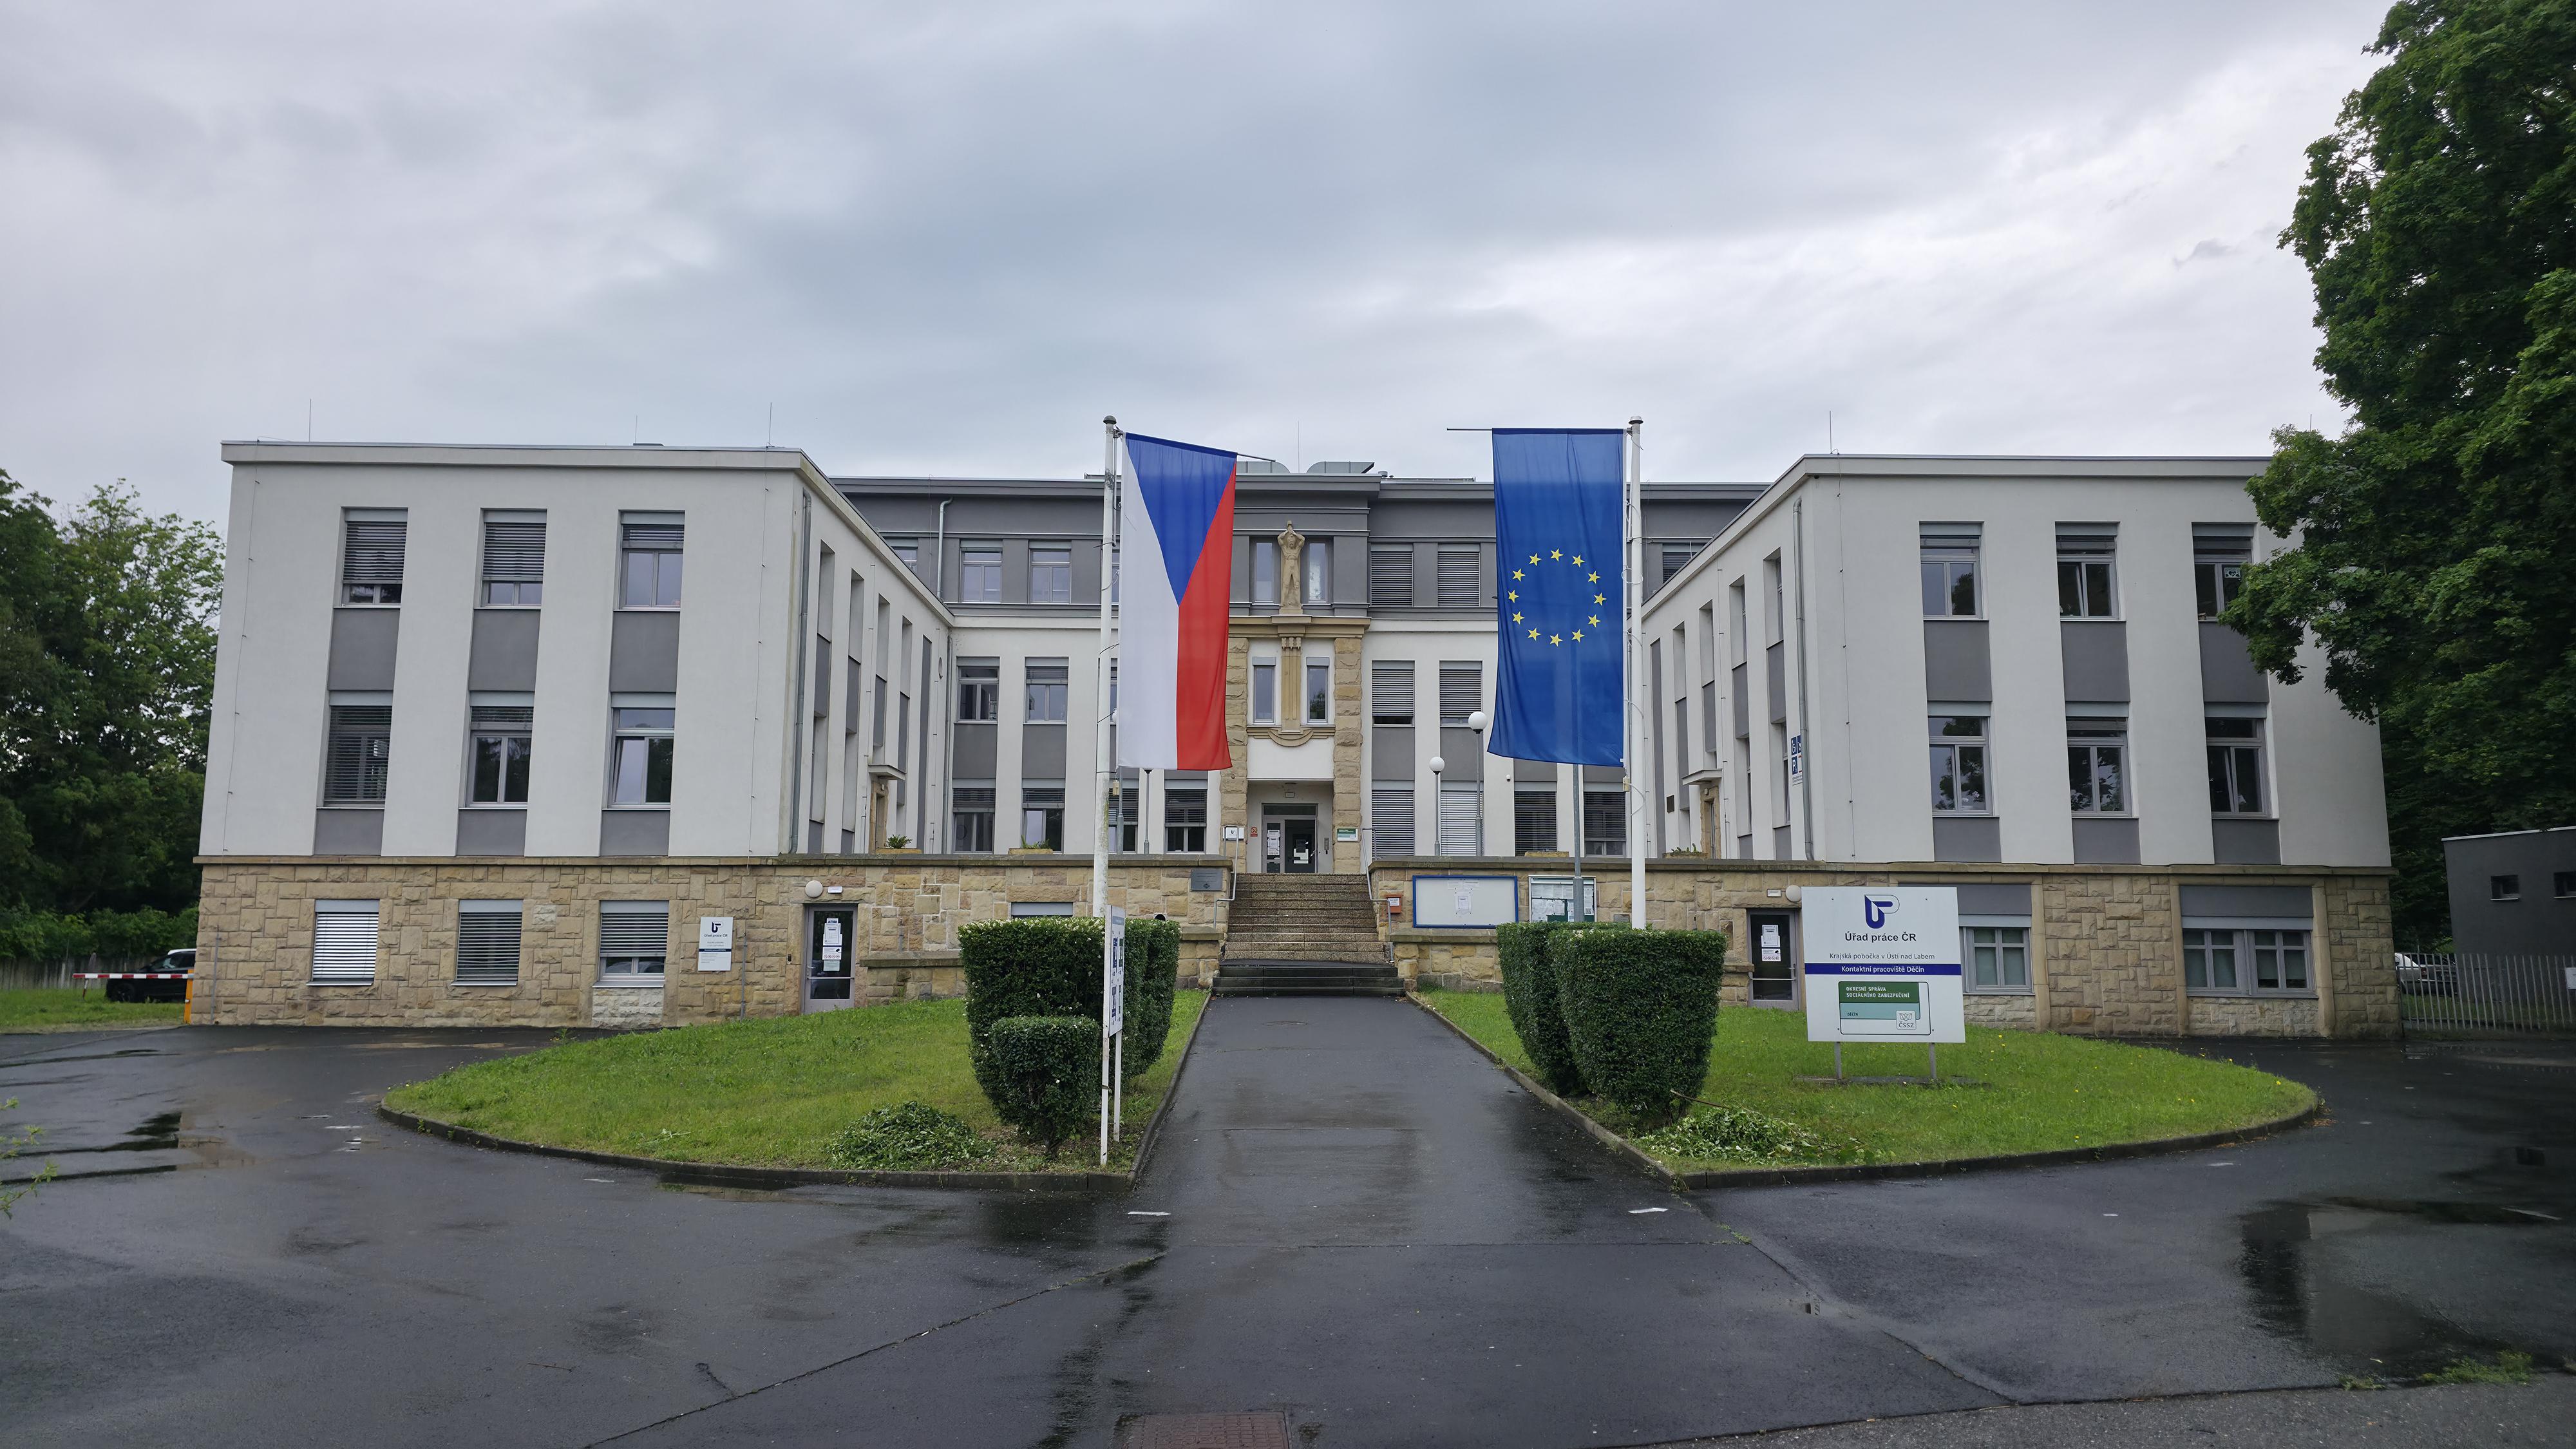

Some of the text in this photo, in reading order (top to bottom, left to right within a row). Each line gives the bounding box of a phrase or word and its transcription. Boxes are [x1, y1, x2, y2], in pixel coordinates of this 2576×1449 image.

[1844, 931, 1917, 943] Úřad práce ČR
[1853, 953, 1880, 961] pobočka
